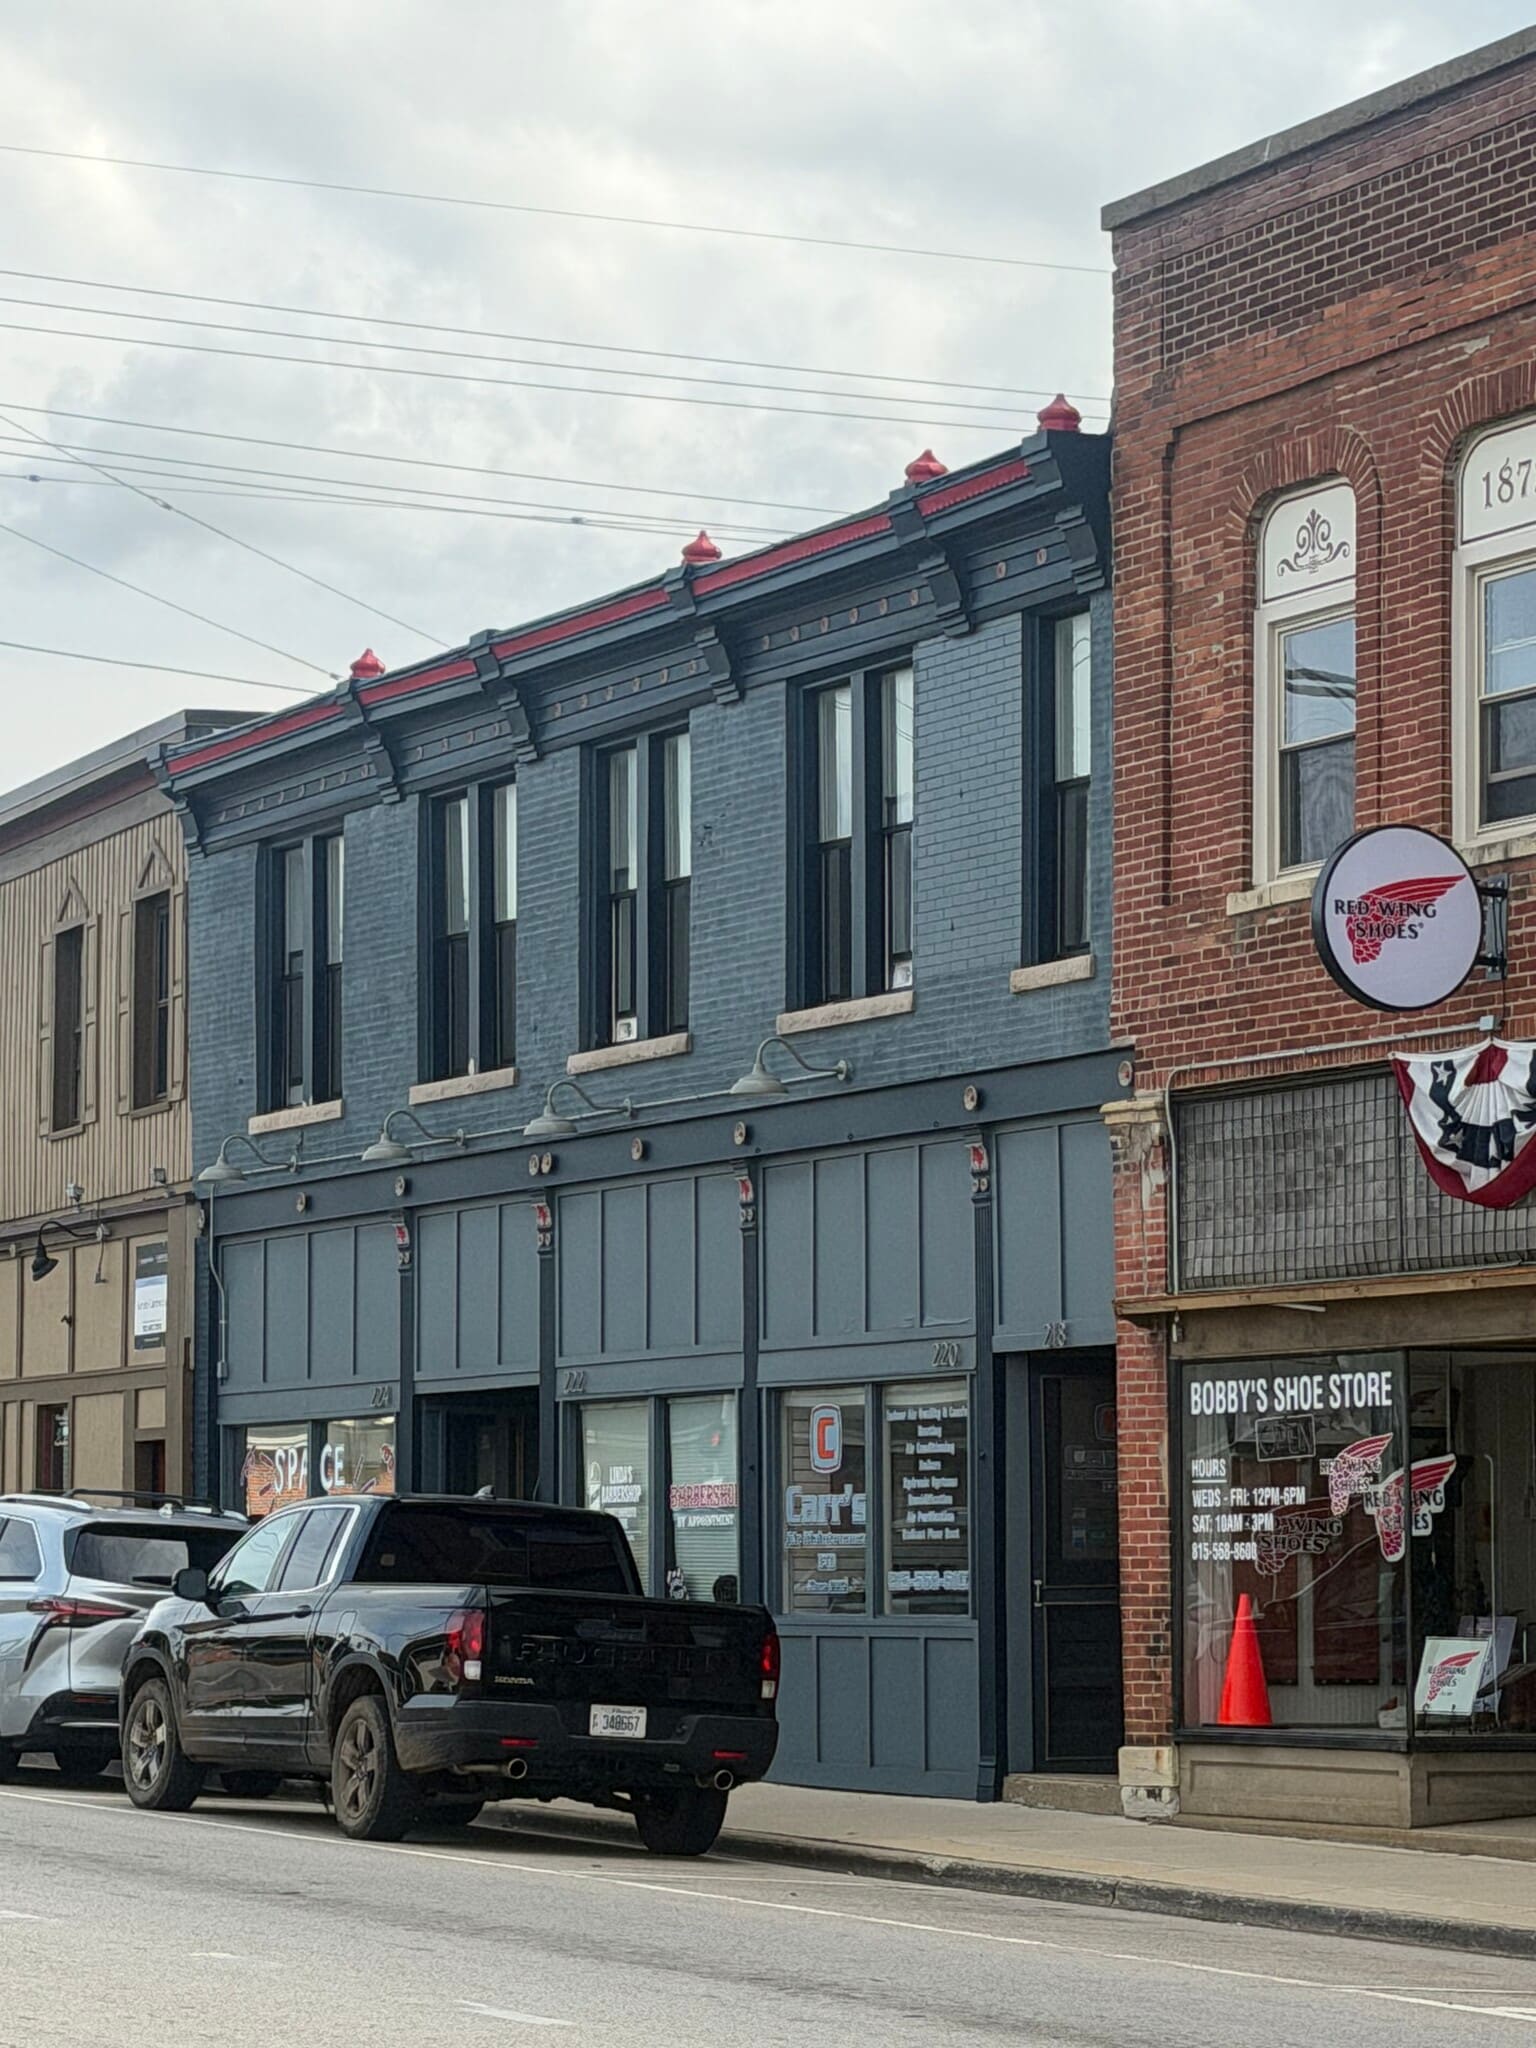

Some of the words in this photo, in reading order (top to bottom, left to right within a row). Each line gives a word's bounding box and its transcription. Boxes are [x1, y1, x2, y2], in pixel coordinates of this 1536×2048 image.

[1482, 456, 1536, 510] 187
[1334, 899, 1369, 915] RED
[1378, 902, 1437, 918] WING
[1355, 922, 1419, 939] SHOES
[932, 1341, 959, 1367] 220
[1190, 1378, 1268, 1415] BOBBY'S
[1274, 1375, 1324, 1411] SHOE
[1329, 1371, 1393, 1408] STORE
[1191, 1459, 1226, 1478] HOURS
[1192, 1488, 1221, 1508] WEDS
[1215, 1513, 1243, 1532] 10AM
[1251, 1512, 1274, 1531] 3PM
